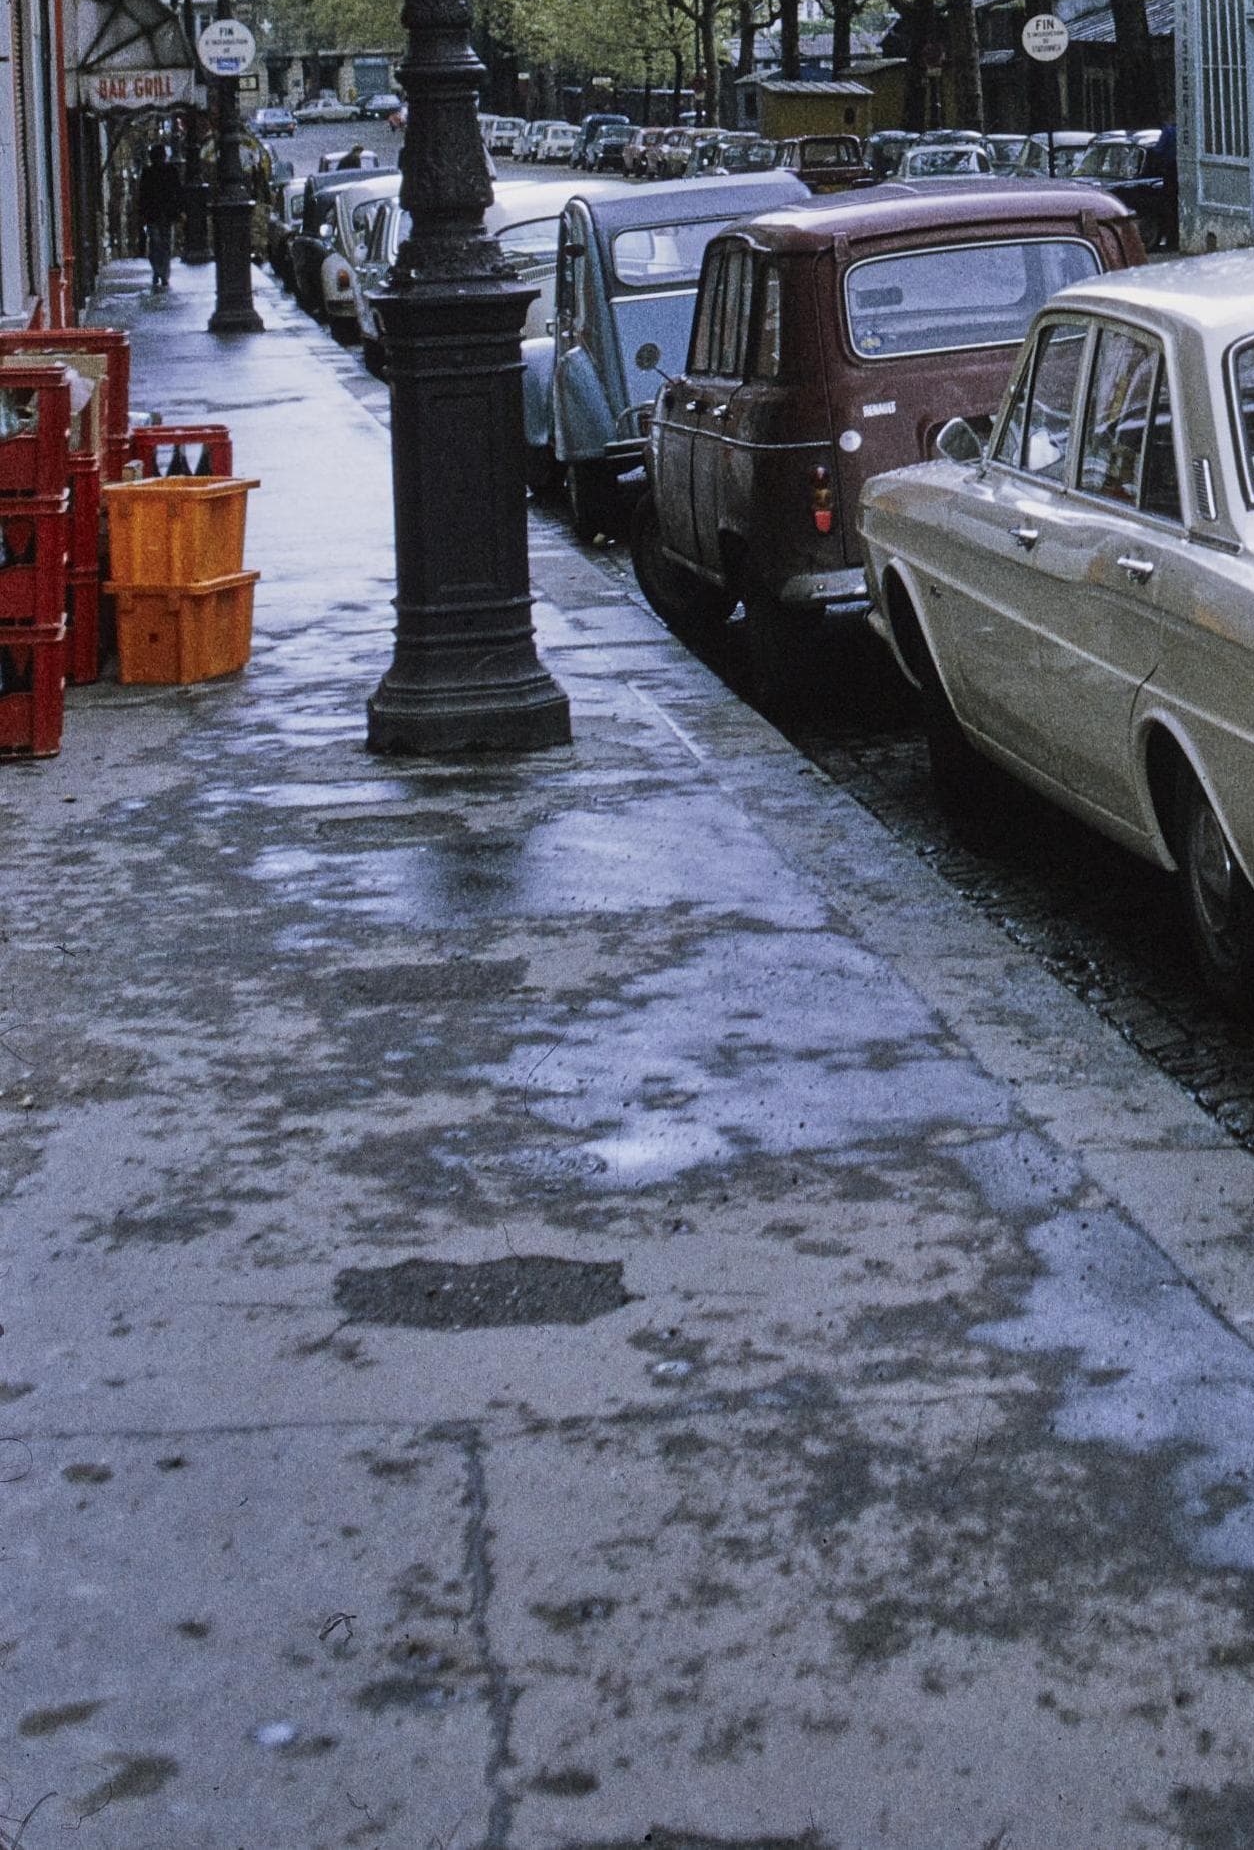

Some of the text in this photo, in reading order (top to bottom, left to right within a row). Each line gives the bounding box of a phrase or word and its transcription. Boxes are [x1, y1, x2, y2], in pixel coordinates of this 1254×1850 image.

[1036, 19, 1054, 30] FIN
[220, 27, 234, 37] FIN
[97, 70, 174, 101] BAR GRILL
